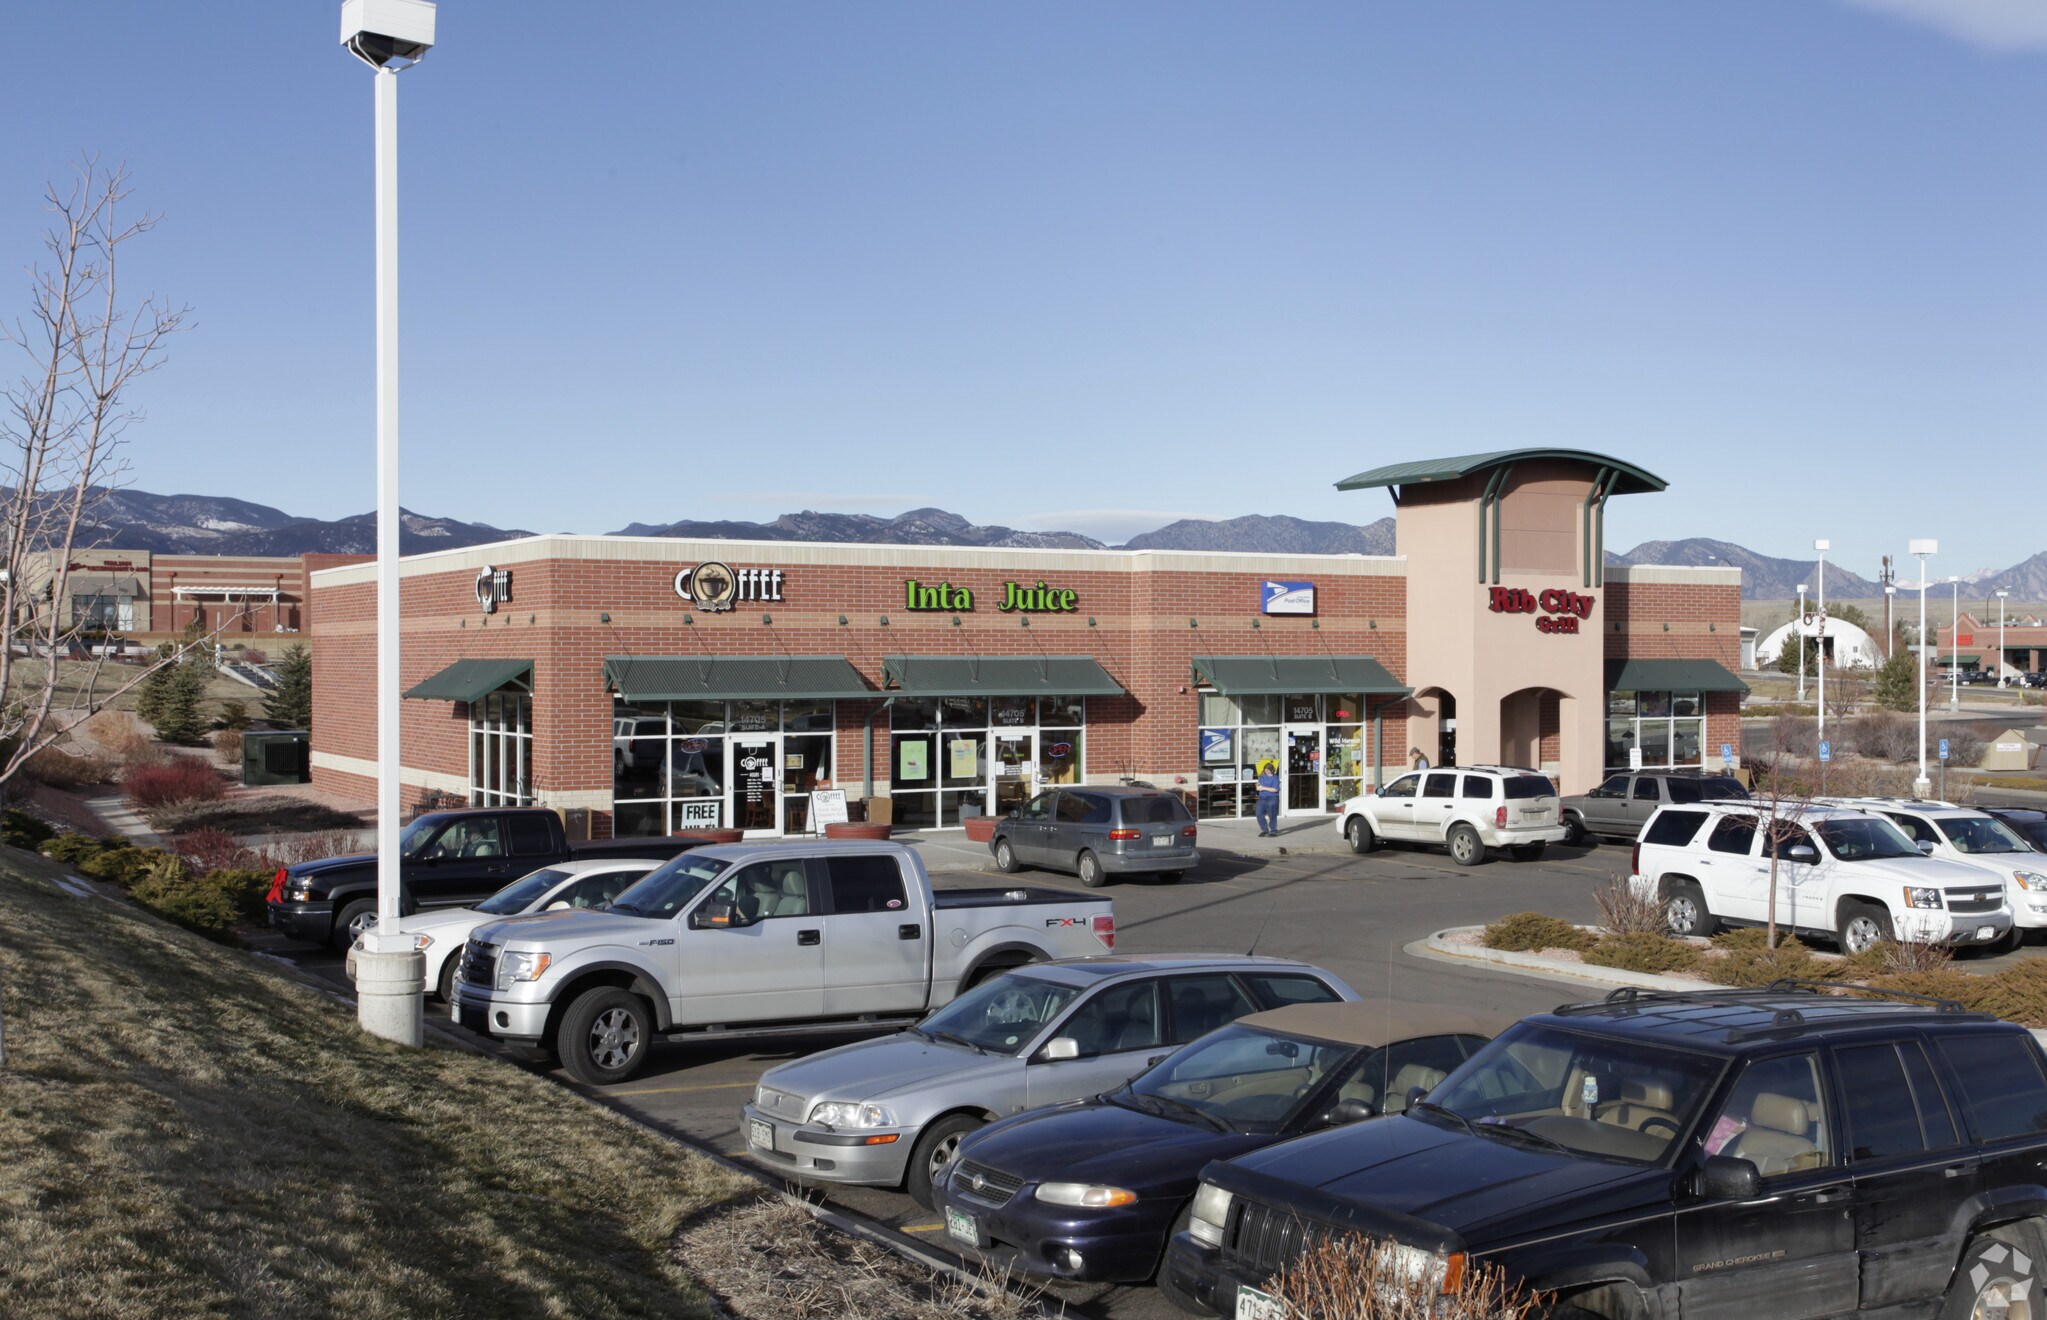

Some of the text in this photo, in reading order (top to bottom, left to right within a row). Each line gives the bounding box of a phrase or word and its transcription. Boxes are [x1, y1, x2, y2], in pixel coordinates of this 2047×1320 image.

[905, 579, 1076, 611] Inta Juice
[1488, 587, 1596, 620] Rib City
[1536, 615, 1579, 634] Grill
[1001, 709, 1025, 717] 14705
[1293, 706, 1314, 714] 14705
[740, 715, 767, 724] 14705
[686, 805, 716, 819] FREE
[1045, 918, 1086, 927] FX4
[1692, 1260, 1724, 1272] GRAND
[1725, 1252, 1771, 1266] CHEROKEE
